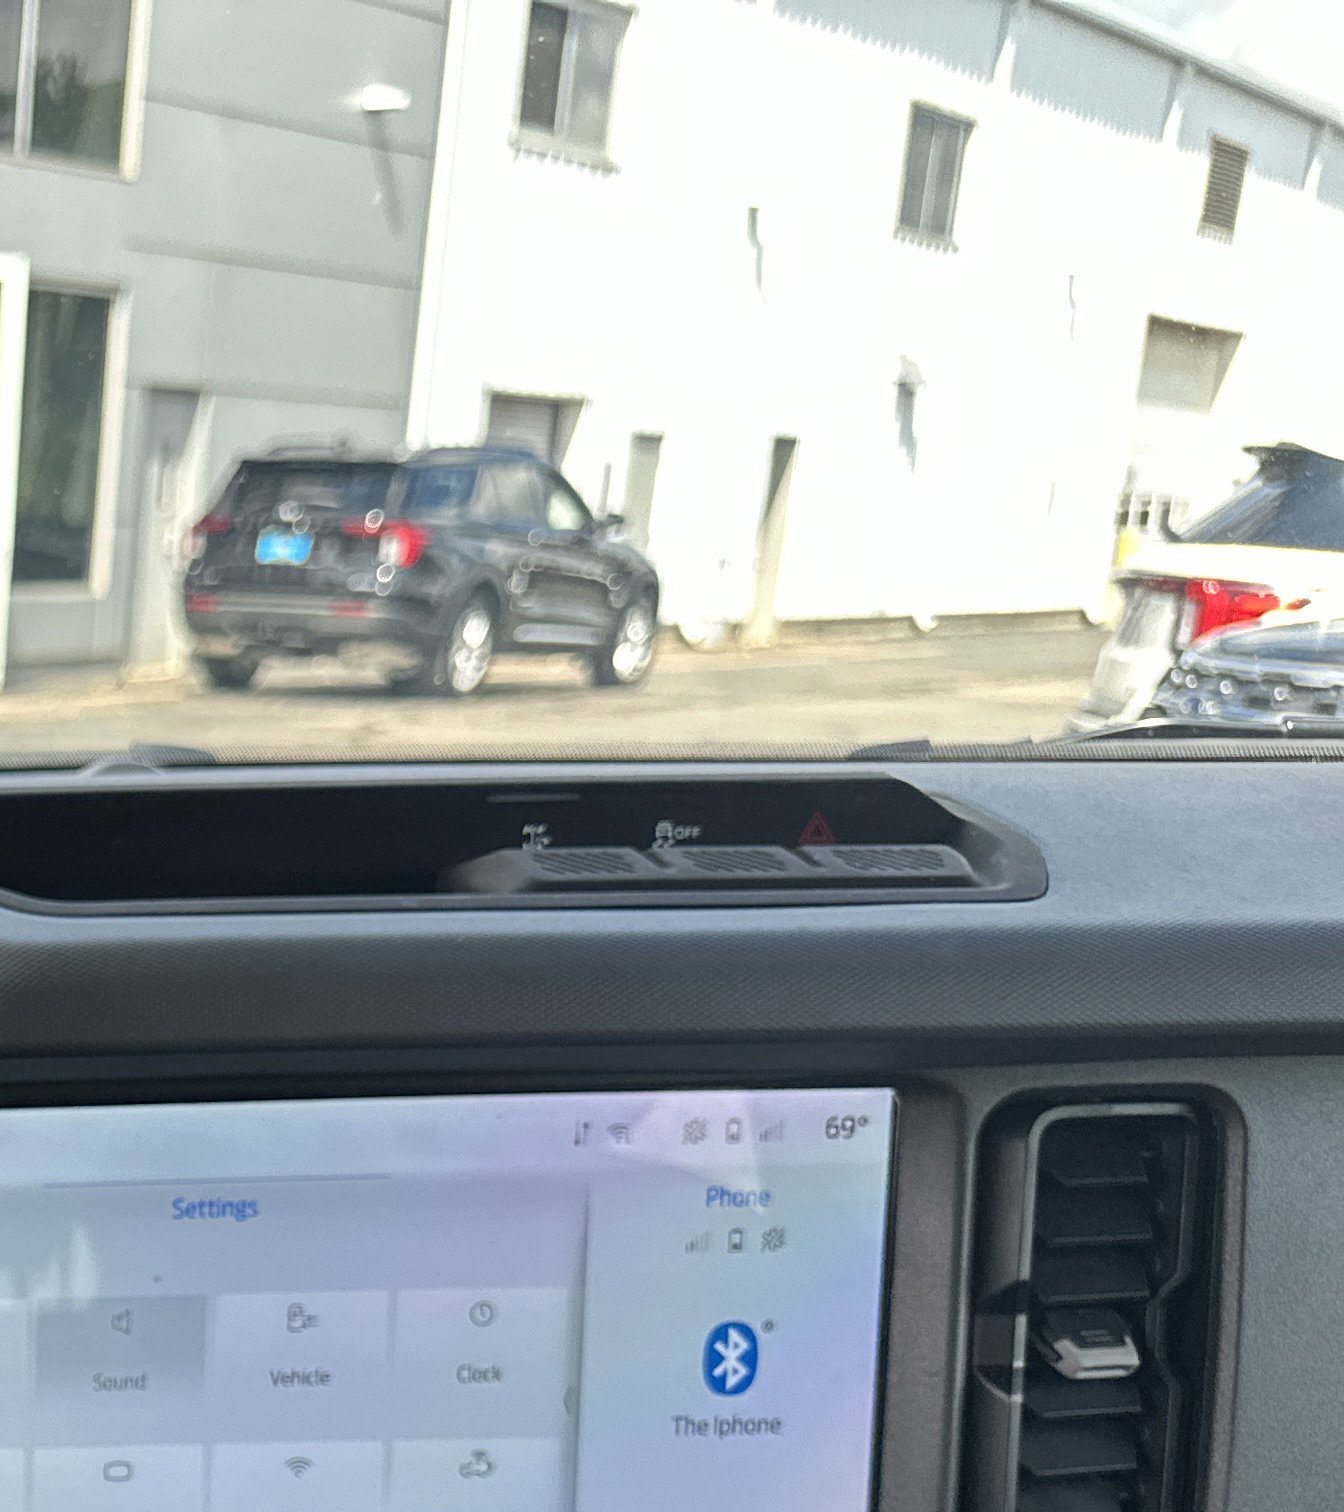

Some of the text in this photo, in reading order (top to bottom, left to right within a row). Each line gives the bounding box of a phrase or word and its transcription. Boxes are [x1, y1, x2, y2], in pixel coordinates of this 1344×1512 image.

[705, 1186, 771, 1209] Phone
[172, 1197, 260, 1222] Settings
[92, 1372, 147, 1391] Sound
[270, 1367, 331, 1387] Vehicle
[456, 1363, 503, 1384] Clock
[672, 1415, 709, 1436] The
